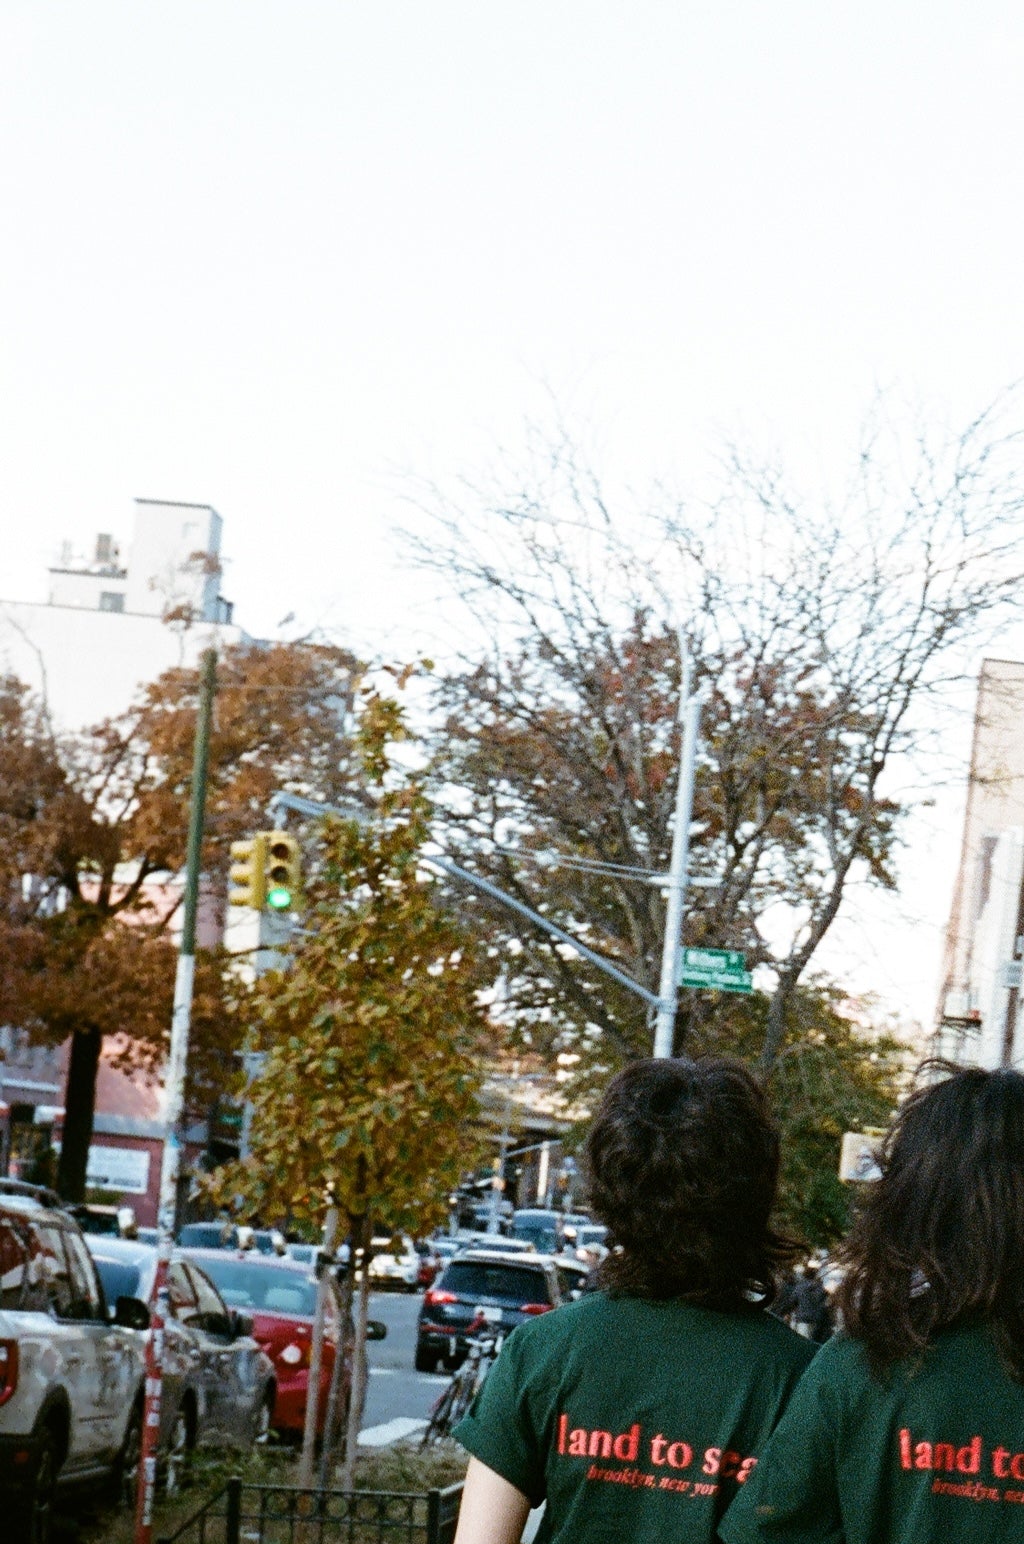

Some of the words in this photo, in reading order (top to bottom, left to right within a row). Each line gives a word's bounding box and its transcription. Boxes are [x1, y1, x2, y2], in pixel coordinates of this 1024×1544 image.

[557, 1413, 641, 1462] land
[650, 1433, 693, 1469] to
[898, 1428, 983, 1475] land
[659, 1475, 690, 1492] new
[690, 1482, 718, 1497] yor
